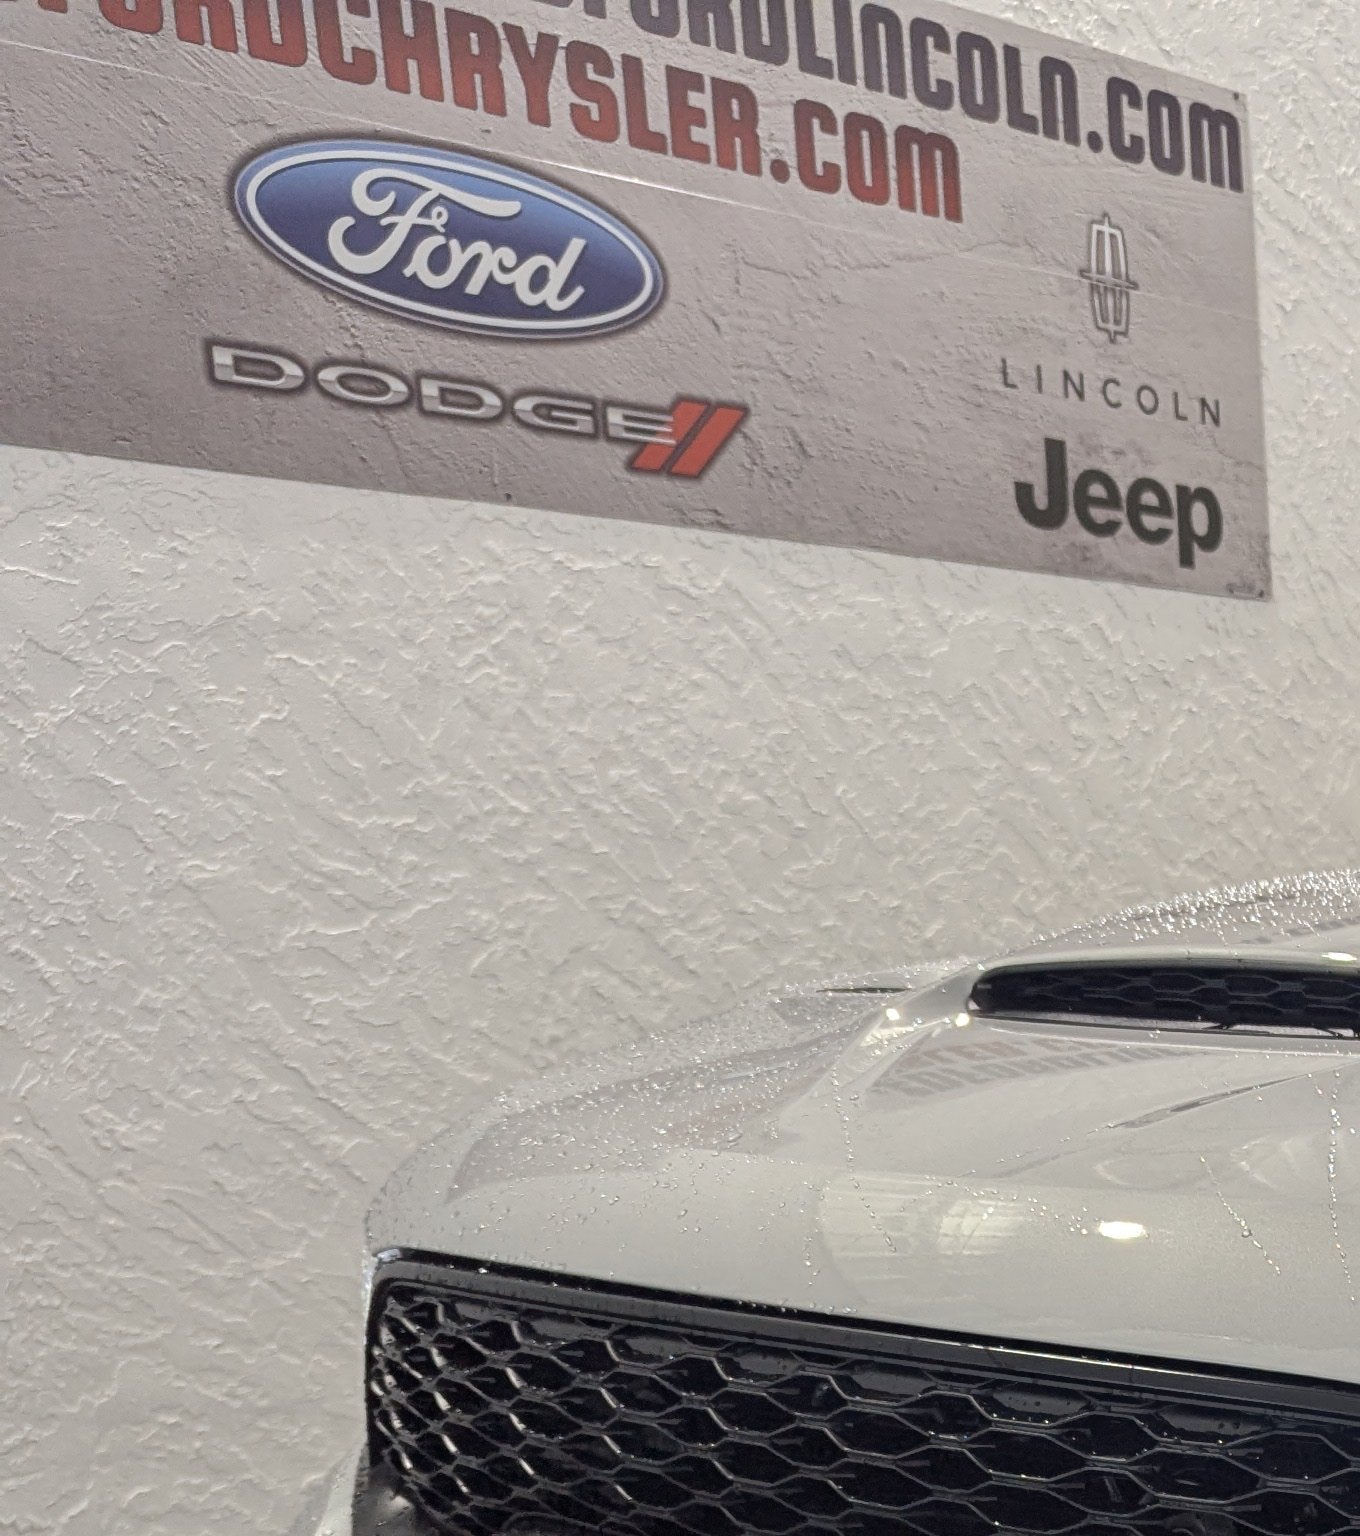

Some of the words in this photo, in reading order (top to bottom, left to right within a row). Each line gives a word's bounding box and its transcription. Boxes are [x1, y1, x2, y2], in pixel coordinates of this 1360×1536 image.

[327, 167, 587, 312] Ford
[210, 345, 678, 446] DODGE
[1000, 357, 1221, 427] LINCOLN
[1013, 437, 1224, 570] Jeep
